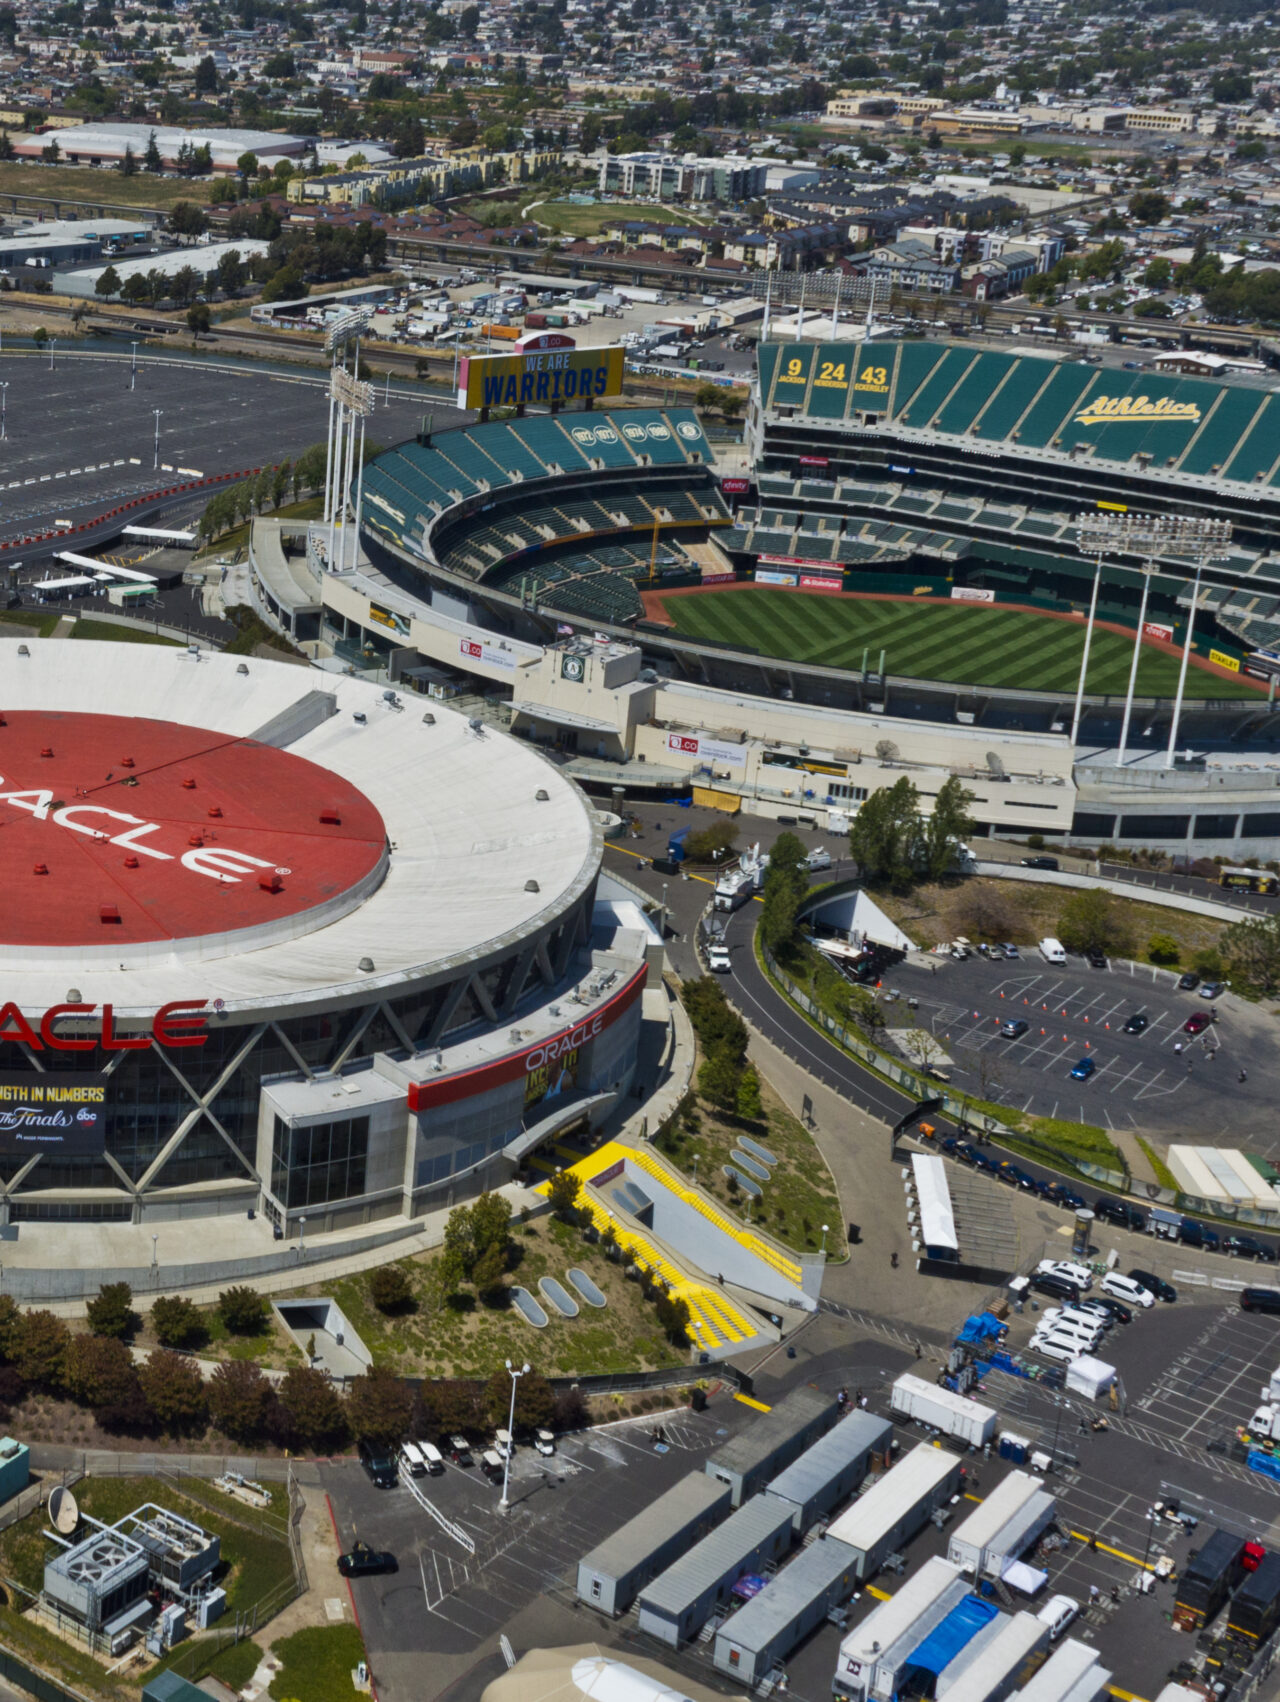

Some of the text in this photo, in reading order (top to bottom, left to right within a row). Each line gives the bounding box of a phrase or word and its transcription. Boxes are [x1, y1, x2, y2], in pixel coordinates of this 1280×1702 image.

[526, 353, 570, 372] WE ARE
[788, 358, 802, 376] 9
[820, 362, 846, 381] 24
[860, 366, 887, 385] 43
[484, 366, 609, 405] WARRIORS
[1073, 396, 1201, 426] Athletics
[1211, 652, 1238, 670] STANLEY
[526, 1011, 606, 1071] ORACLE
[31, 1087, 44, 1101] IN
[46, 1087, 105, 1102] NUMBERS
[13, 1106, 73, 1128] Finals
[76, 1111, 97, 1121] abc
